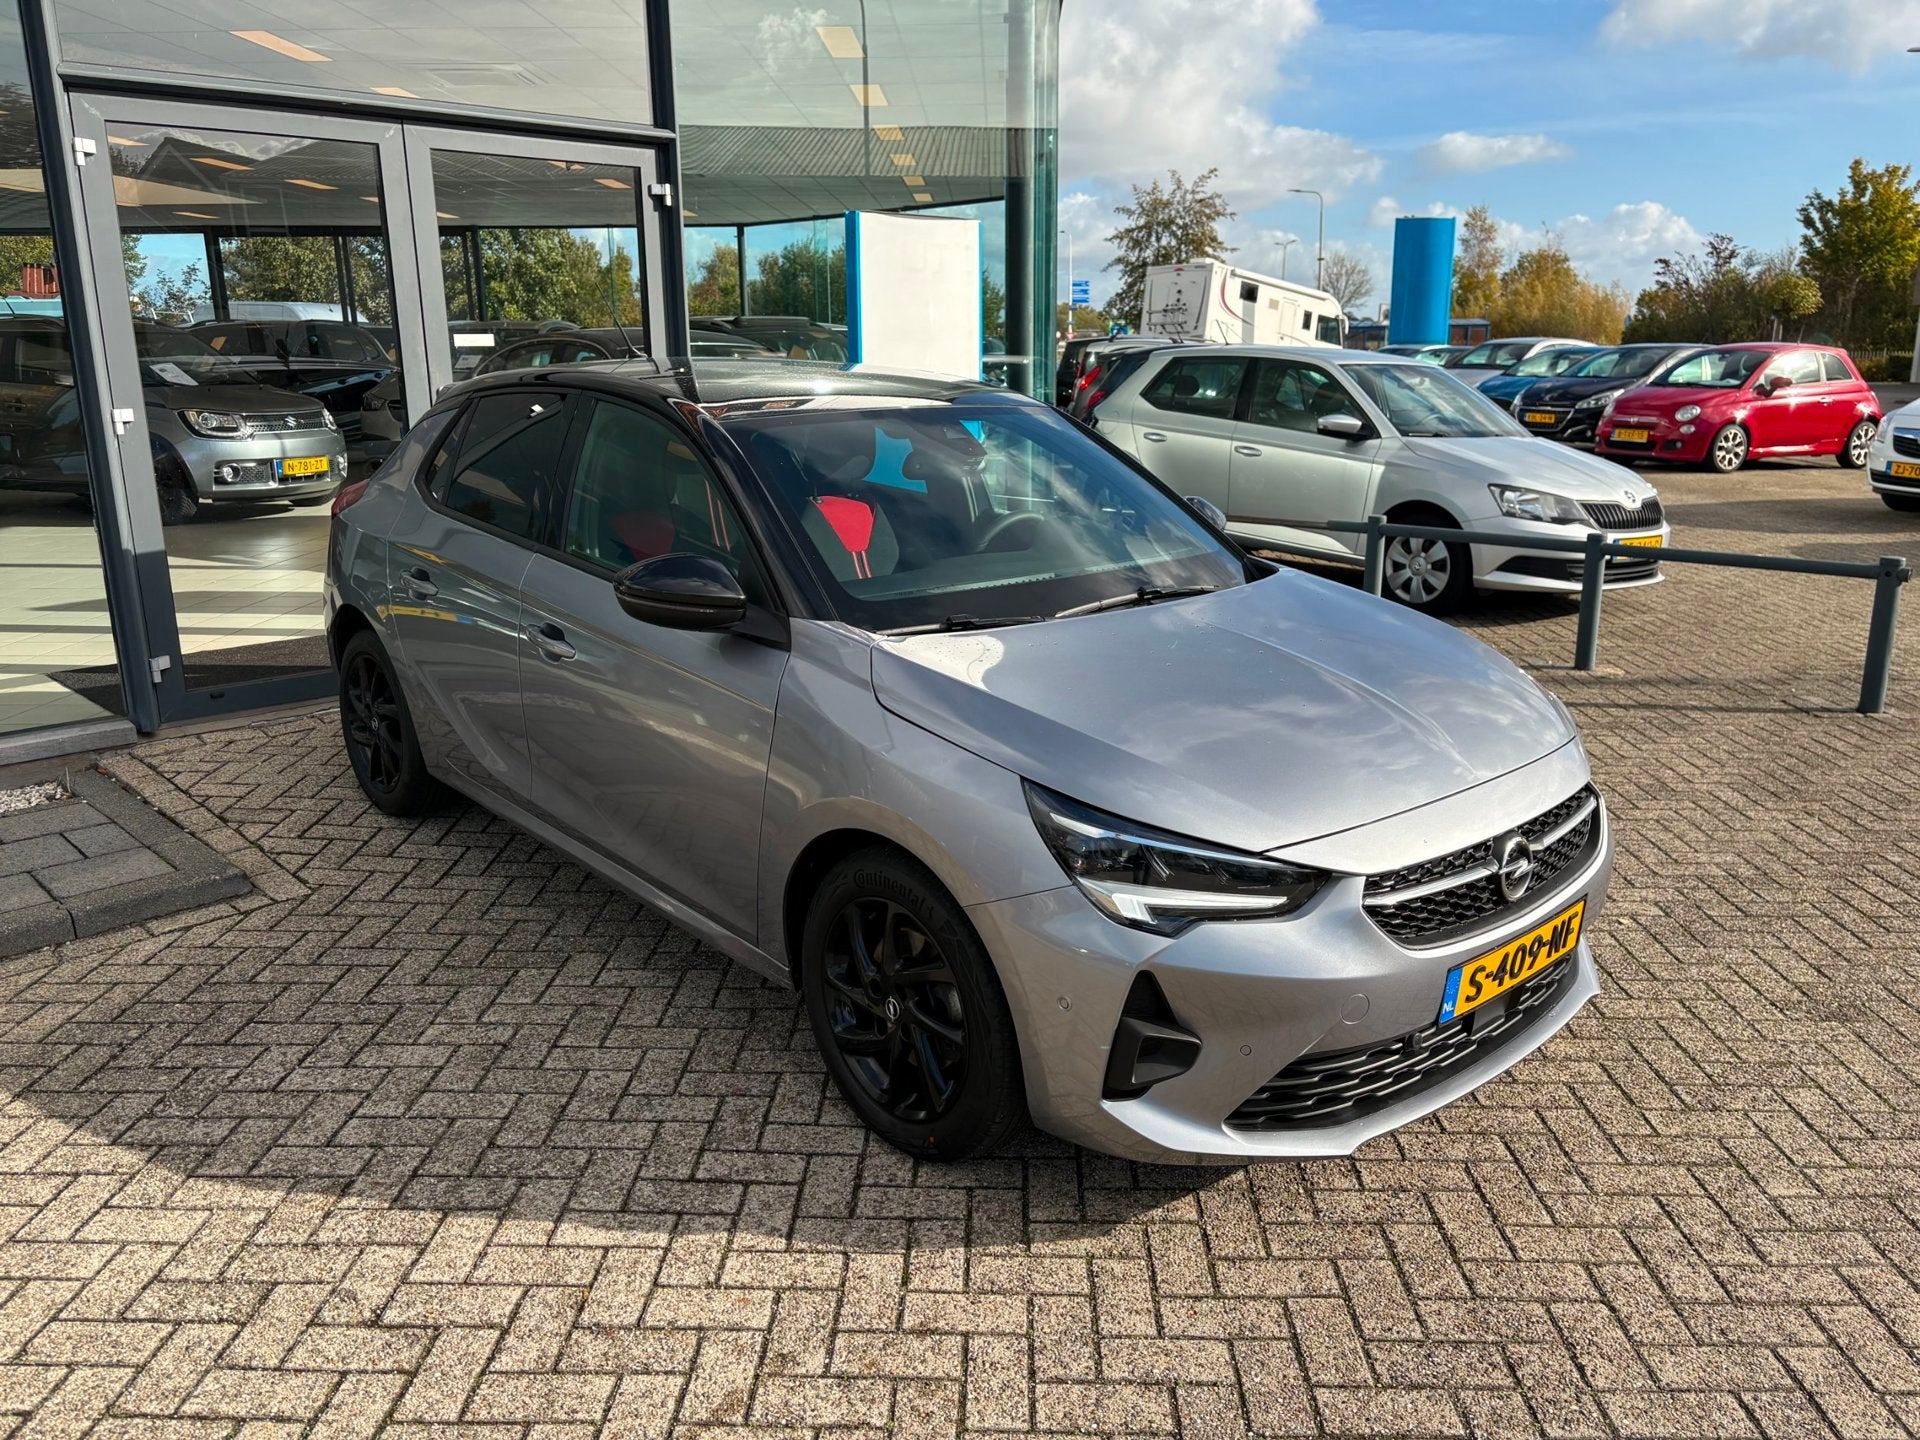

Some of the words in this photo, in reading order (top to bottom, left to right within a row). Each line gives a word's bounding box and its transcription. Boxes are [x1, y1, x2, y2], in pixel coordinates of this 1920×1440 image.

[287, 459, 324, 472] N-781-ZT
[854, 868, 926, 913] Continental
[1465, 911, 1579, 1004] S-409-NF
[1442, 1001, 1454, 1014] NL
